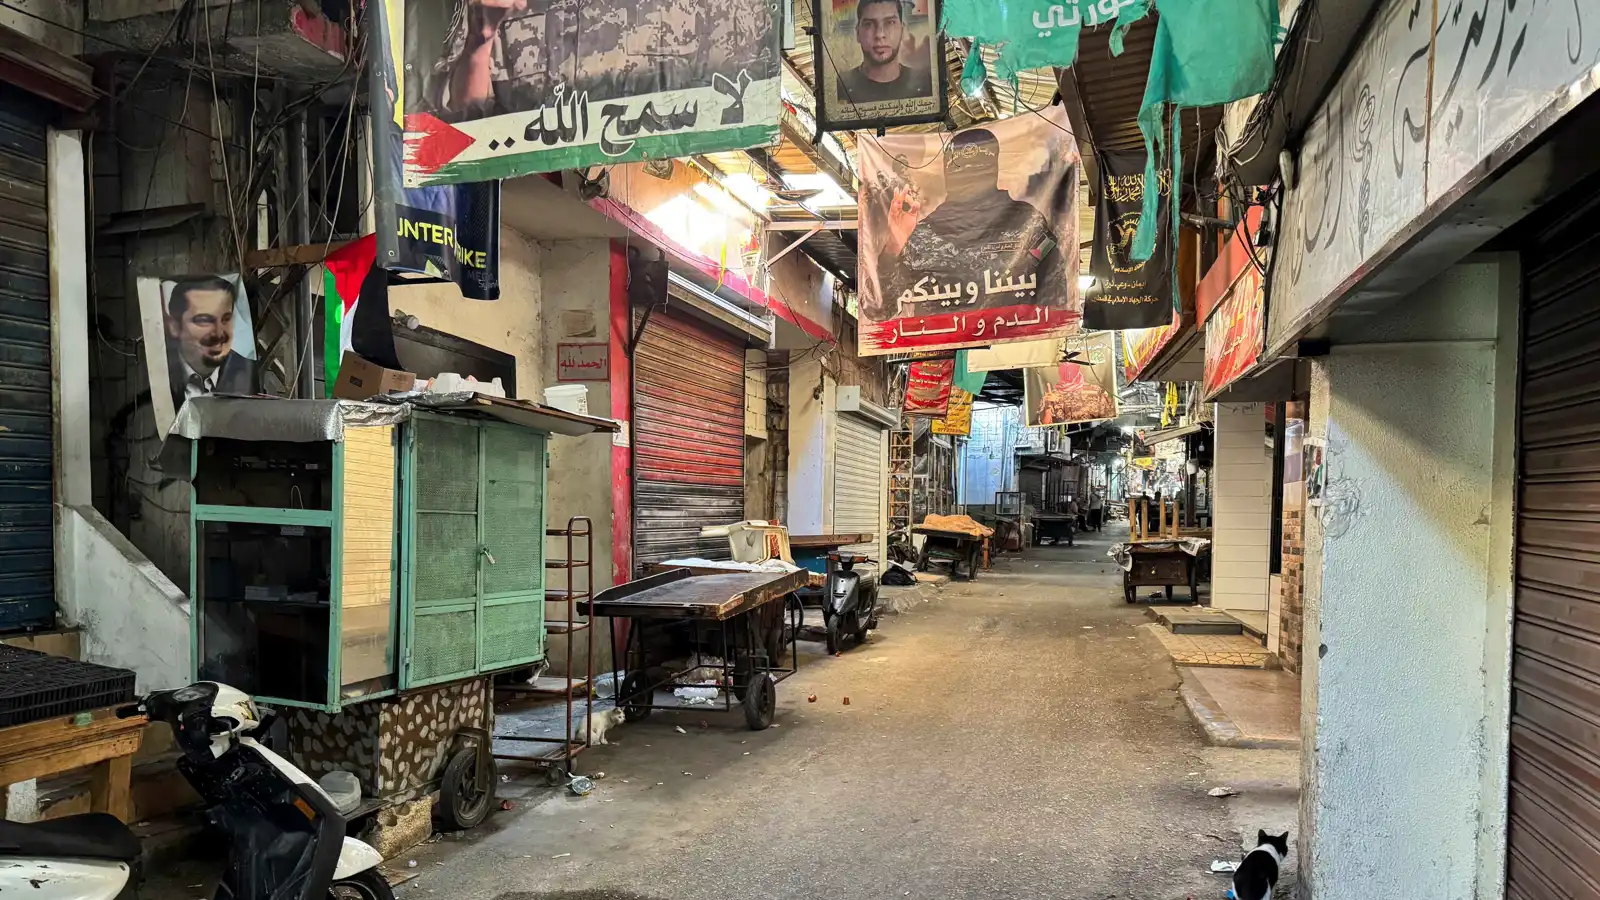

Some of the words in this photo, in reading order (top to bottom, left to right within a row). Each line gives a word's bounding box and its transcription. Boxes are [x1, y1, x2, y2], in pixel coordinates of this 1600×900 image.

[1033, 0, 1136, 38] ورتي
[712, 69, 752, 125] لا
[599, 98, 698, 156] سمح
[984, 268, 1037, 298] بيننا
[886, 315, 966, 344] النار
[577, 357, 607, 370] الحمد
